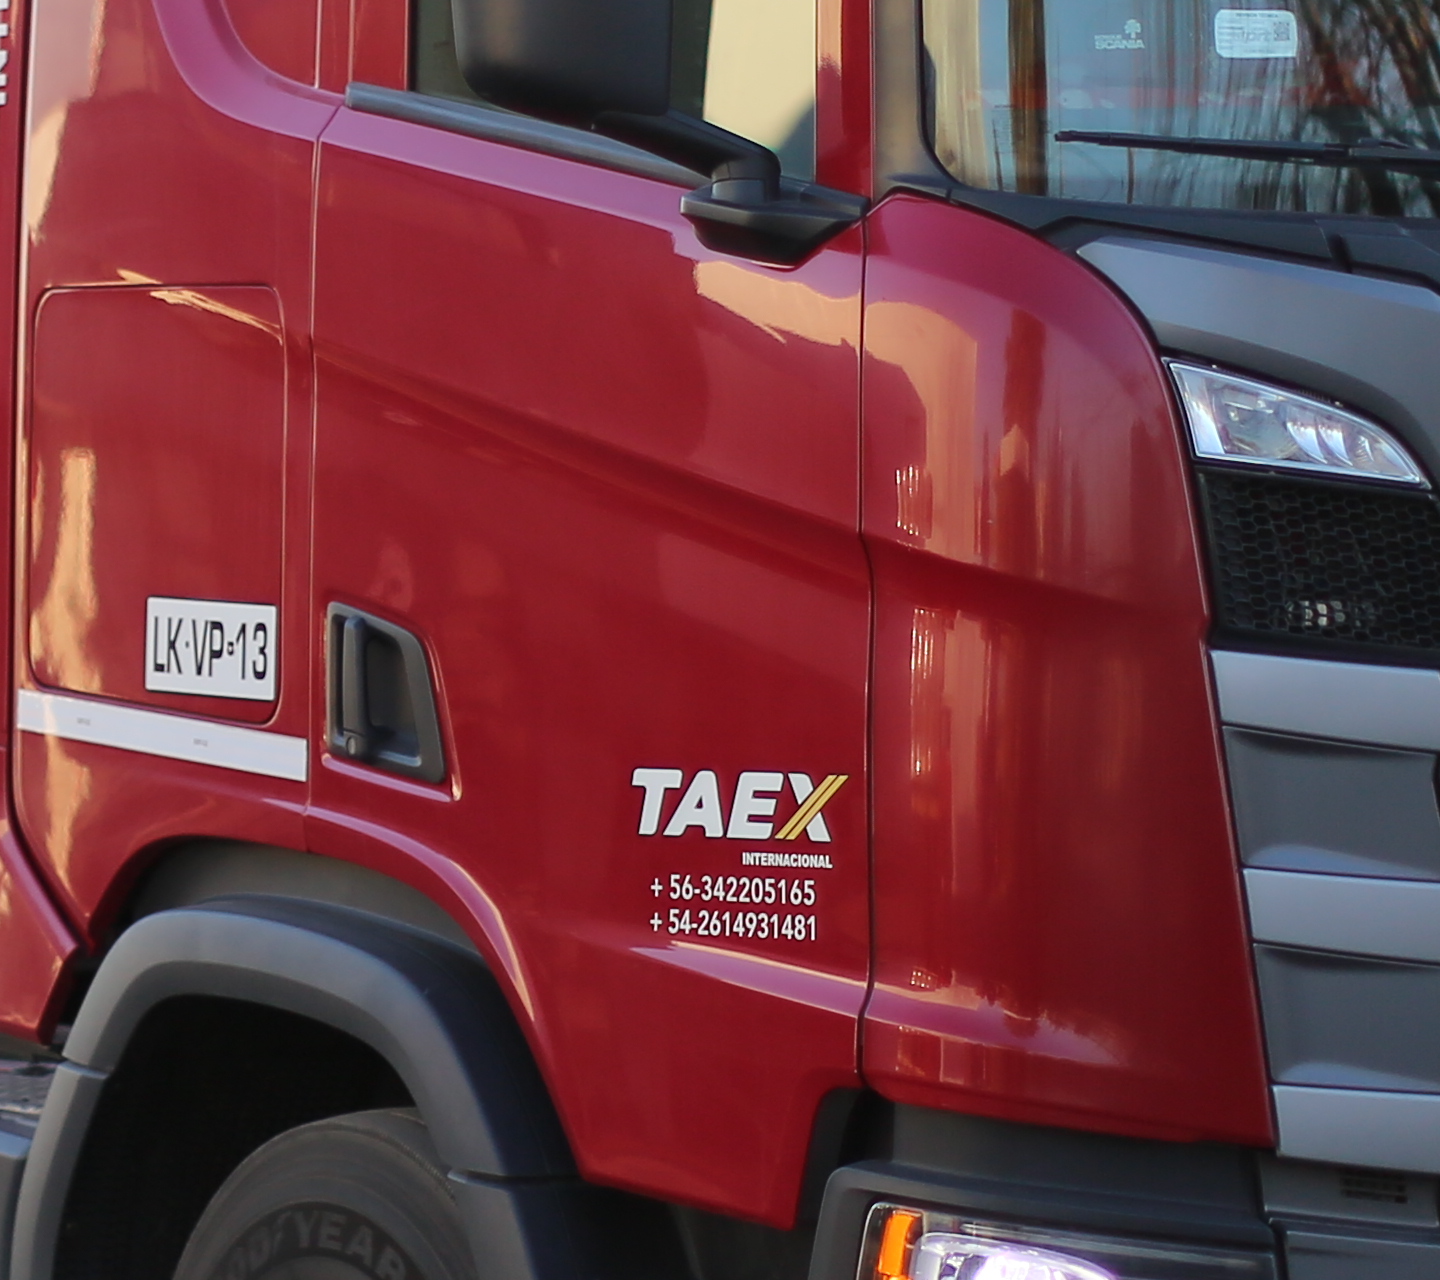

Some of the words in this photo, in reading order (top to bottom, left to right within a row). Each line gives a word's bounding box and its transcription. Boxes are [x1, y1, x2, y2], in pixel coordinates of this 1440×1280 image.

[631, 767, 849, 842] TAEX
[741, 851, 833, 868] INTERNACIONAL
[669, 873, 816, 906] 56-342205165
[667, 908, 817, 941] 54-2614931481
